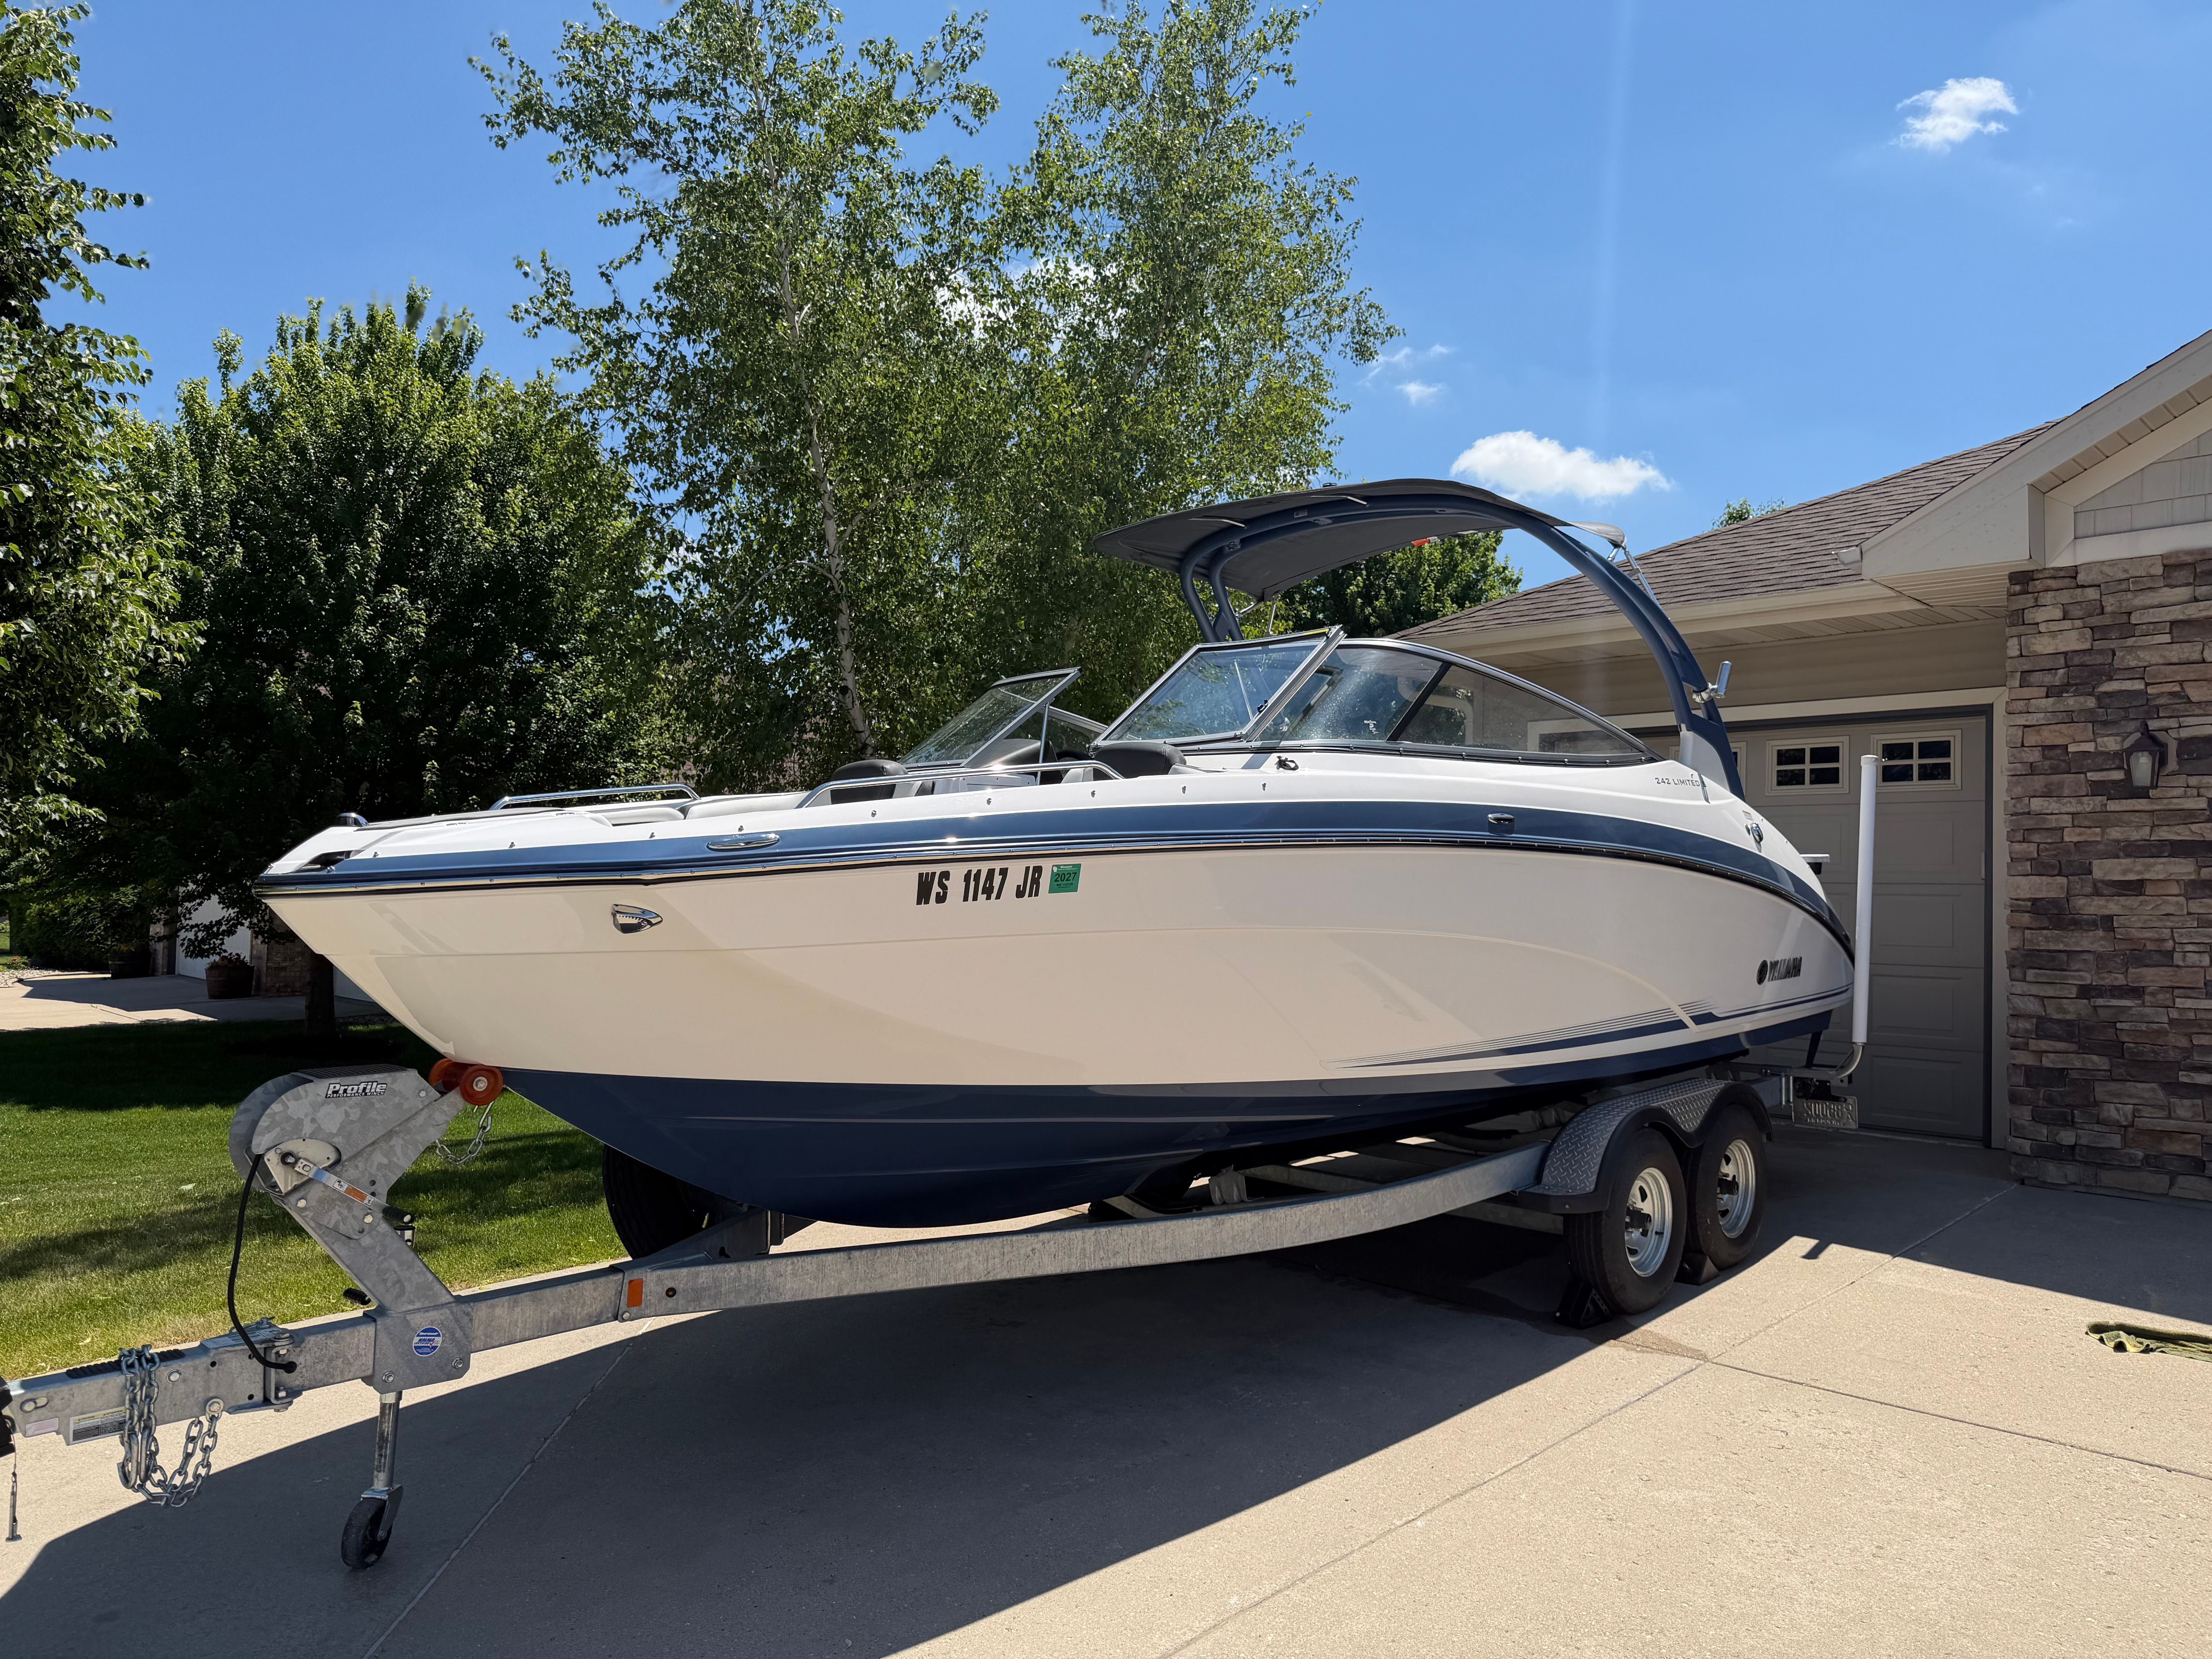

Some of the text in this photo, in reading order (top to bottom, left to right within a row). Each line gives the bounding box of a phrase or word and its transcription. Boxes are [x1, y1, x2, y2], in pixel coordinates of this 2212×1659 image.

[1672, 778, 1700, 787] LIMITED
[1054, 872, 1077, 882] 2027
[916, 866, 1043, 905] WS 1147 JR
[327, 1082, 387, 1094] Profile
